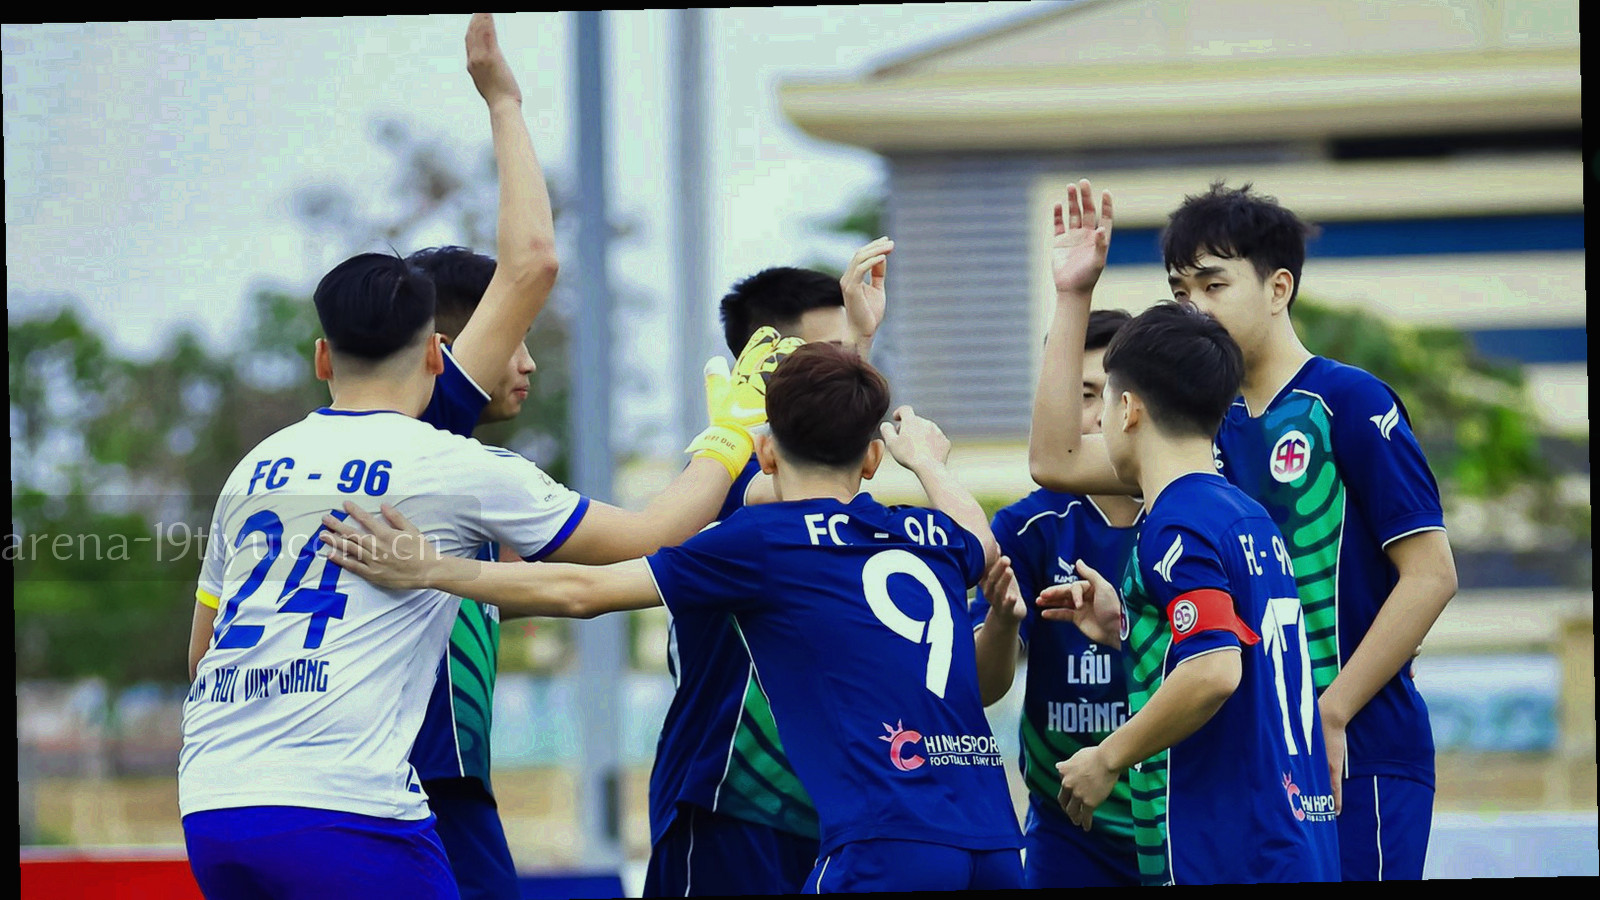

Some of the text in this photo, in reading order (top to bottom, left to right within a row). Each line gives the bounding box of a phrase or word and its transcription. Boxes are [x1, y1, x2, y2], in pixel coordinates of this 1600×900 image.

[1273, 437, 1306, 475] 96
[247, 457, 295, 496] FC
[337, 459, 393, 496] 96
[804, 513, 853, 546] FC
[904, 513, 949, 546] 96
[1238, 533, 1263, 576] FC
[217, 509, 348, 650] 24
[861, 549, 954, 699] 9
[278, 658, 330, 695] GIANG
[1067, 644, 1111, 684] LẨU
[1260, 597, 1314, 756] 17
[1047, 697, 1126, 733] HOÀNG
